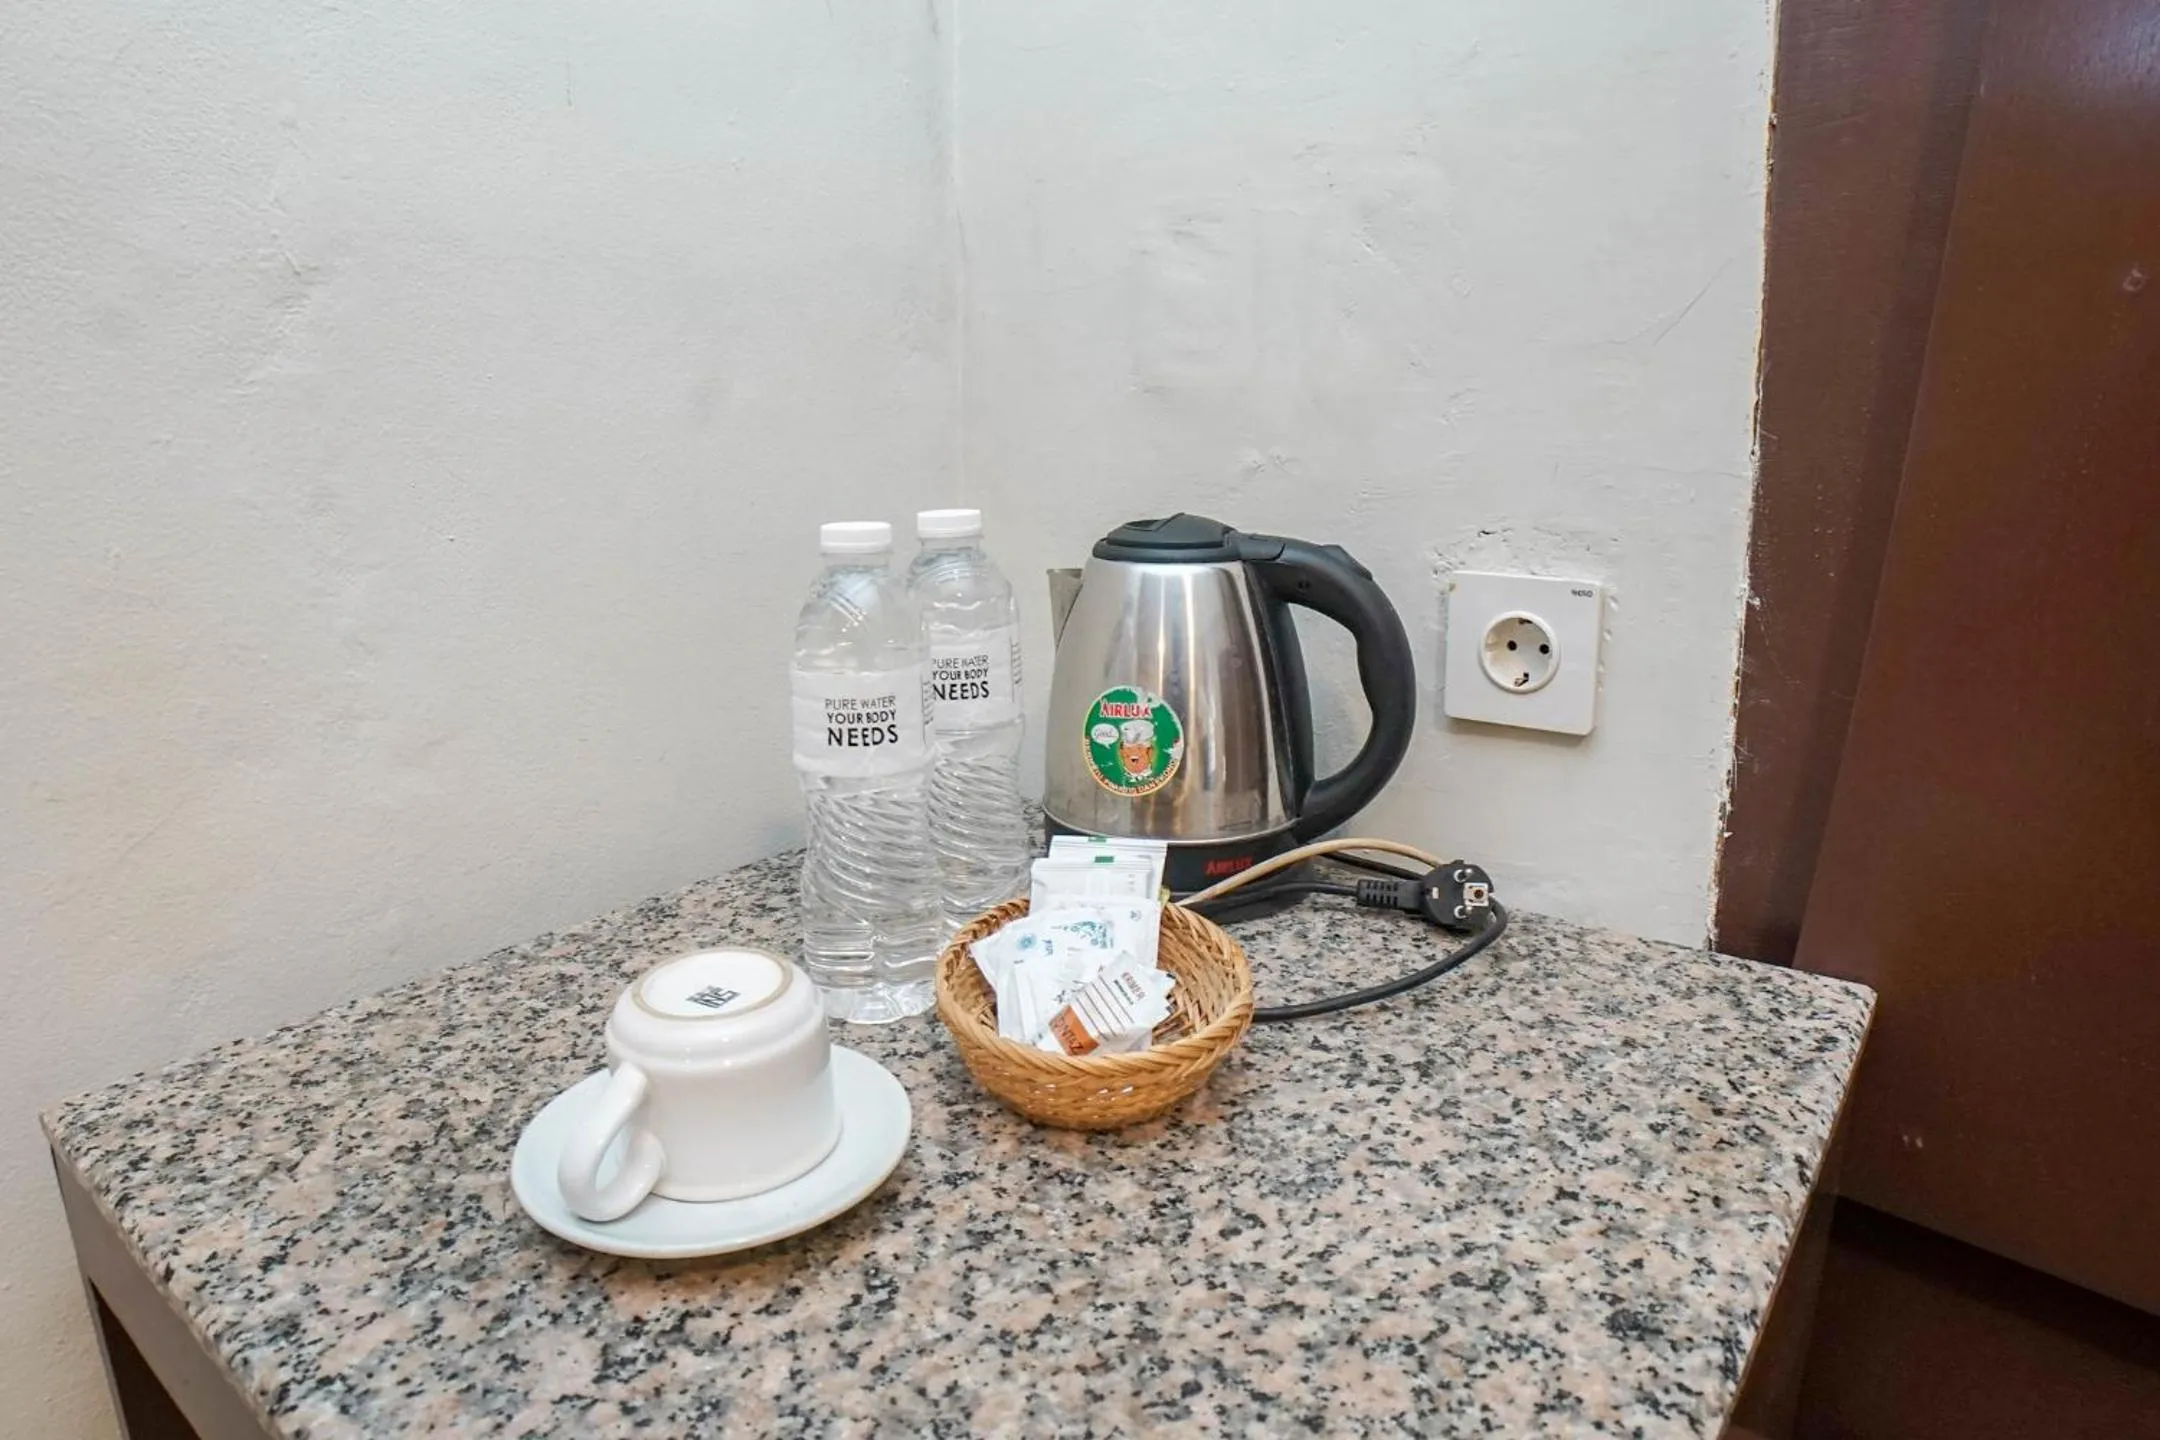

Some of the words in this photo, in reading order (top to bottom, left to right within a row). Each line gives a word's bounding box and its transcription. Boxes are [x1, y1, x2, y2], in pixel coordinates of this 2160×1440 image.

[931, 670, 962, 681] YOUR
[964, 667, 989, 680] BODY
[931, 681, 990, 700] NEEDS
[825, 697, 857, 711] PURE
[861, 695, 896, 710] WATER
[827, 712, 864, 725] YOUR
[866, 710, 897, 724] BODY
[827, 724, 899, 747] NEEDS
